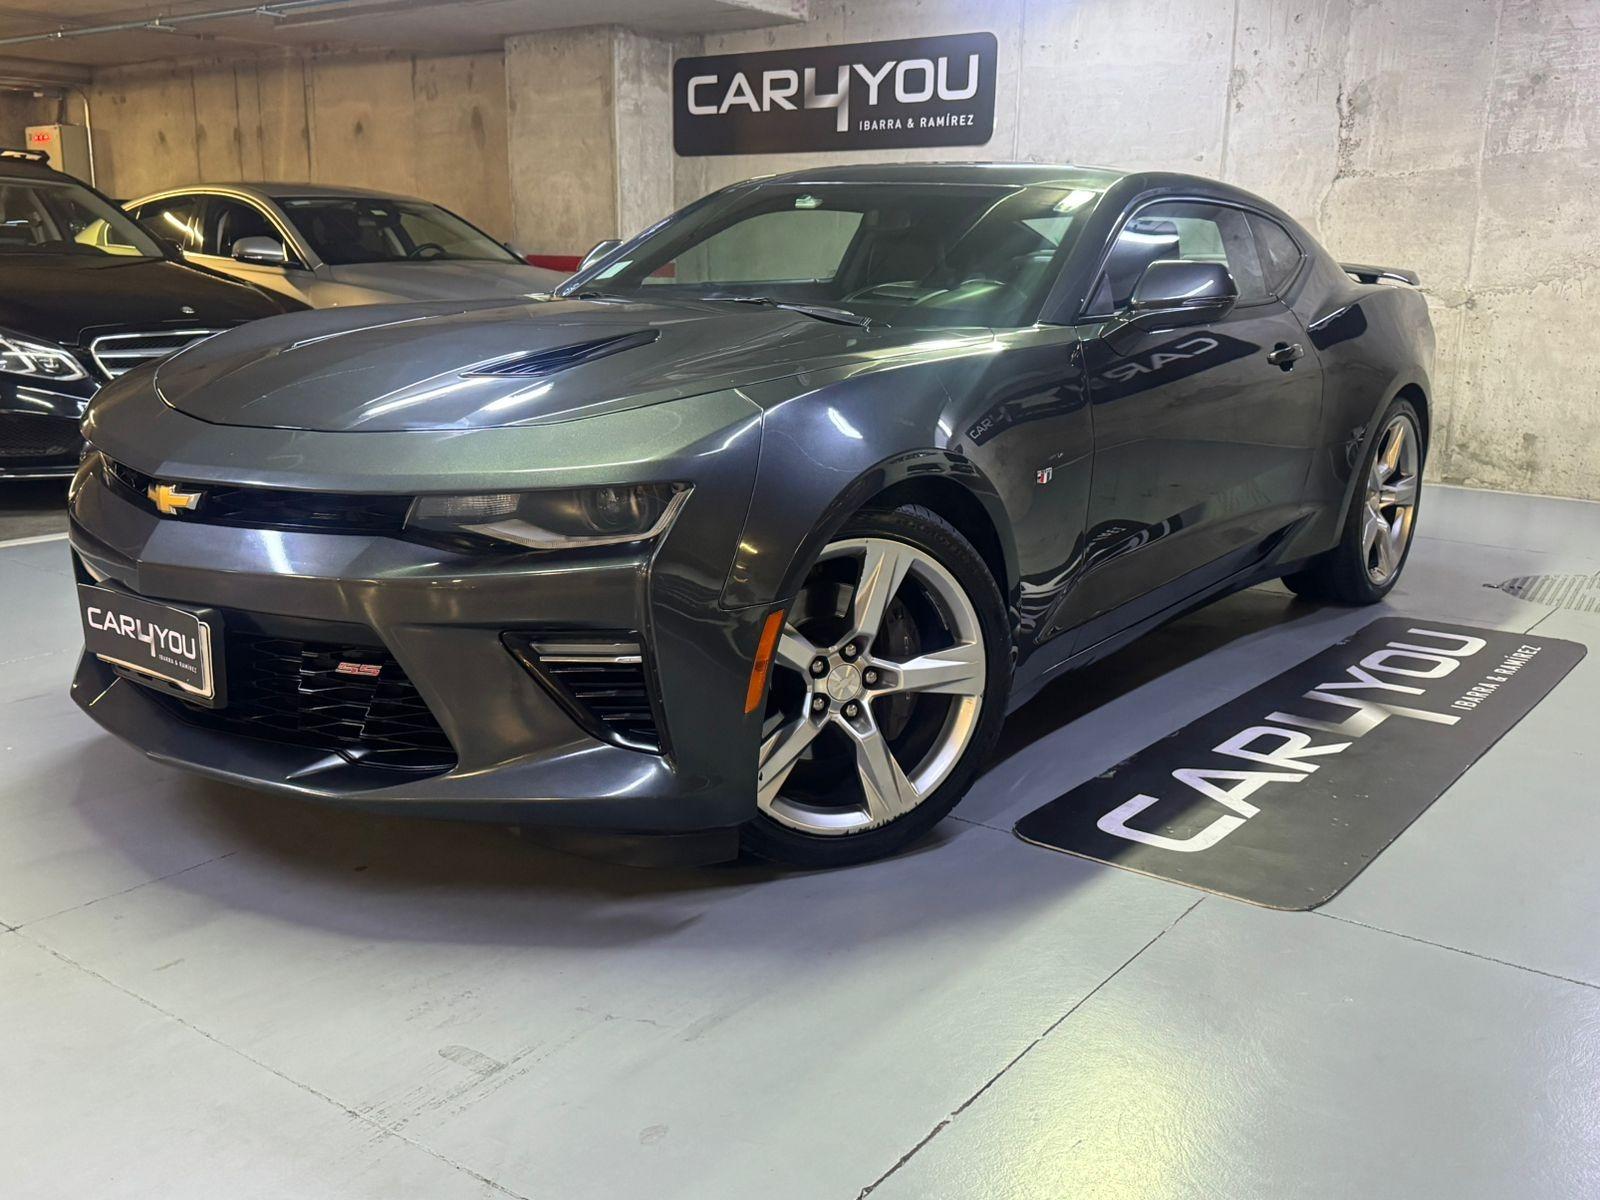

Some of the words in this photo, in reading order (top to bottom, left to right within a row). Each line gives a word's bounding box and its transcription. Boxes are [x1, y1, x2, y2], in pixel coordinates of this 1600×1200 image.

[687, 54, 979, 132] CAR4YOU
[859, 119, 902, 131] IBARRA
[906, 118, 915, 129] &
[920, 113, 974, 128] RAMÍREZ
[87, 606, 196, 660] CAR4YOU
[335, 662, 383, 677] SS
[1450, 682, 1501, 711] IBARRA
[1494, 644, 1542, 675] RAMÍREZ
[1097, 628, 1488, 853] CAR4YOU
